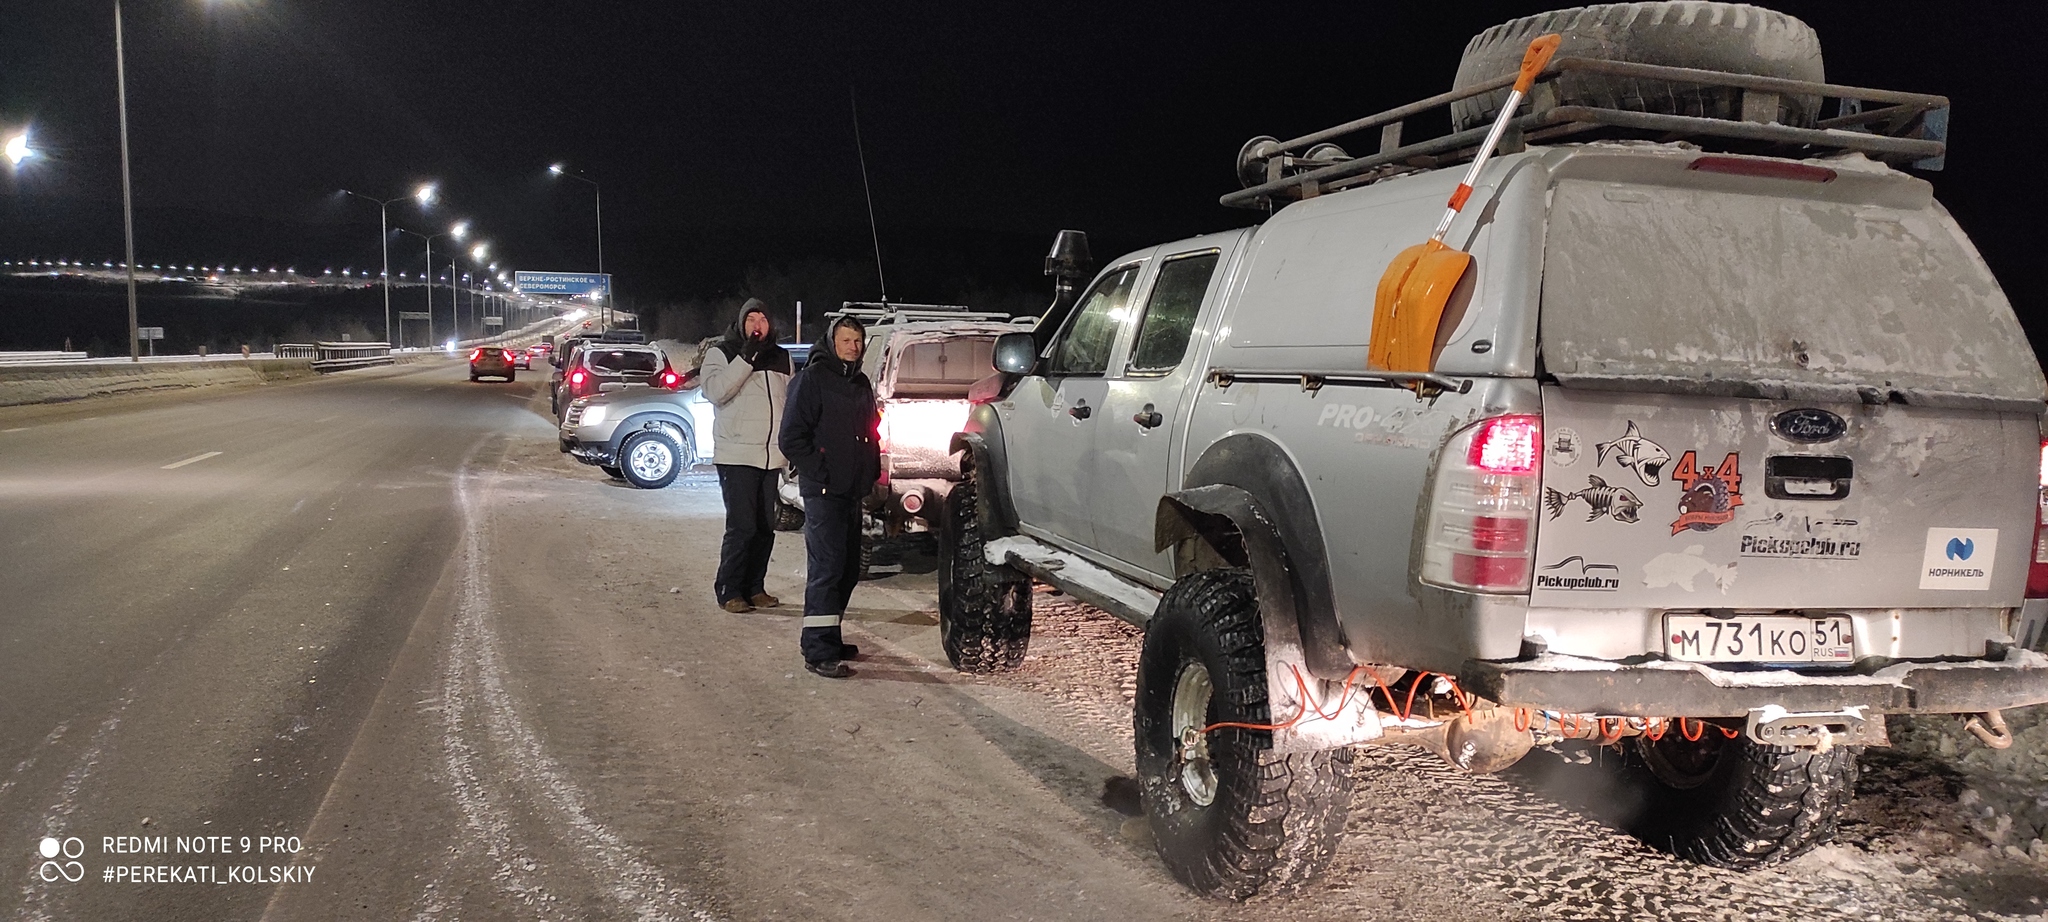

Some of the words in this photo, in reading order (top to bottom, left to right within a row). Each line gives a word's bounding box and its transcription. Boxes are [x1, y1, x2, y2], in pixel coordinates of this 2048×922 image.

[519, 276, 588, 284] ВЕРХНЕ-РОСТИНСКОЕ
[1790, 412, 1830, 436] Ford
[1928, 568, 1984, 577] НОРНИКЕЛЬ
[1537, 575, 1619, 589] Pickupclub.ru
[1815, 621, 1841, 646] 51
[1814, 648, 1833, 656] RUS
